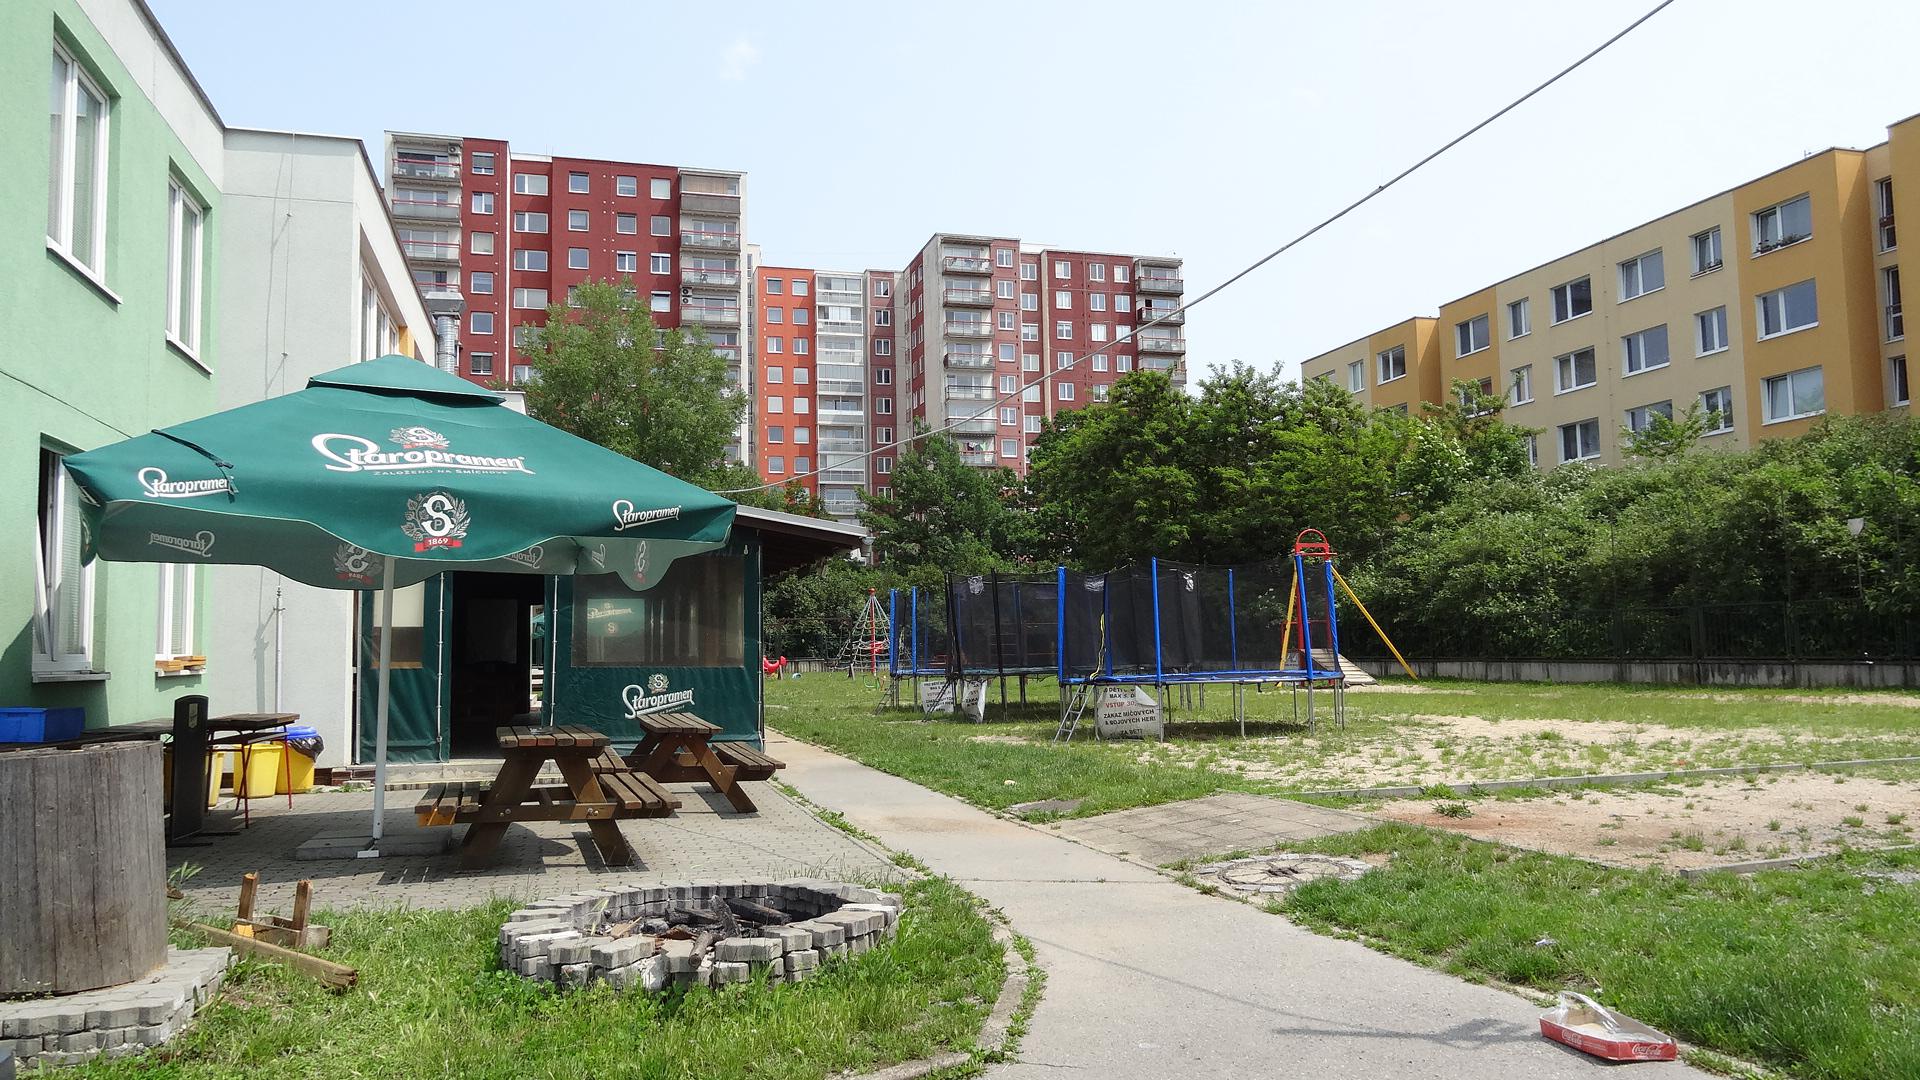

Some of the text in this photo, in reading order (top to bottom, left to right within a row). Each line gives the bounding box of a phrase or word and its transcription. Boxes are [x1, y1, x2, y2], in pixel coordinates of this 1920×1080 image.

[311, 433, 536, 475] Staropramen
[613, 500, 681, 531] Staropramen
[622, 684, 695, 719] Staropramen
